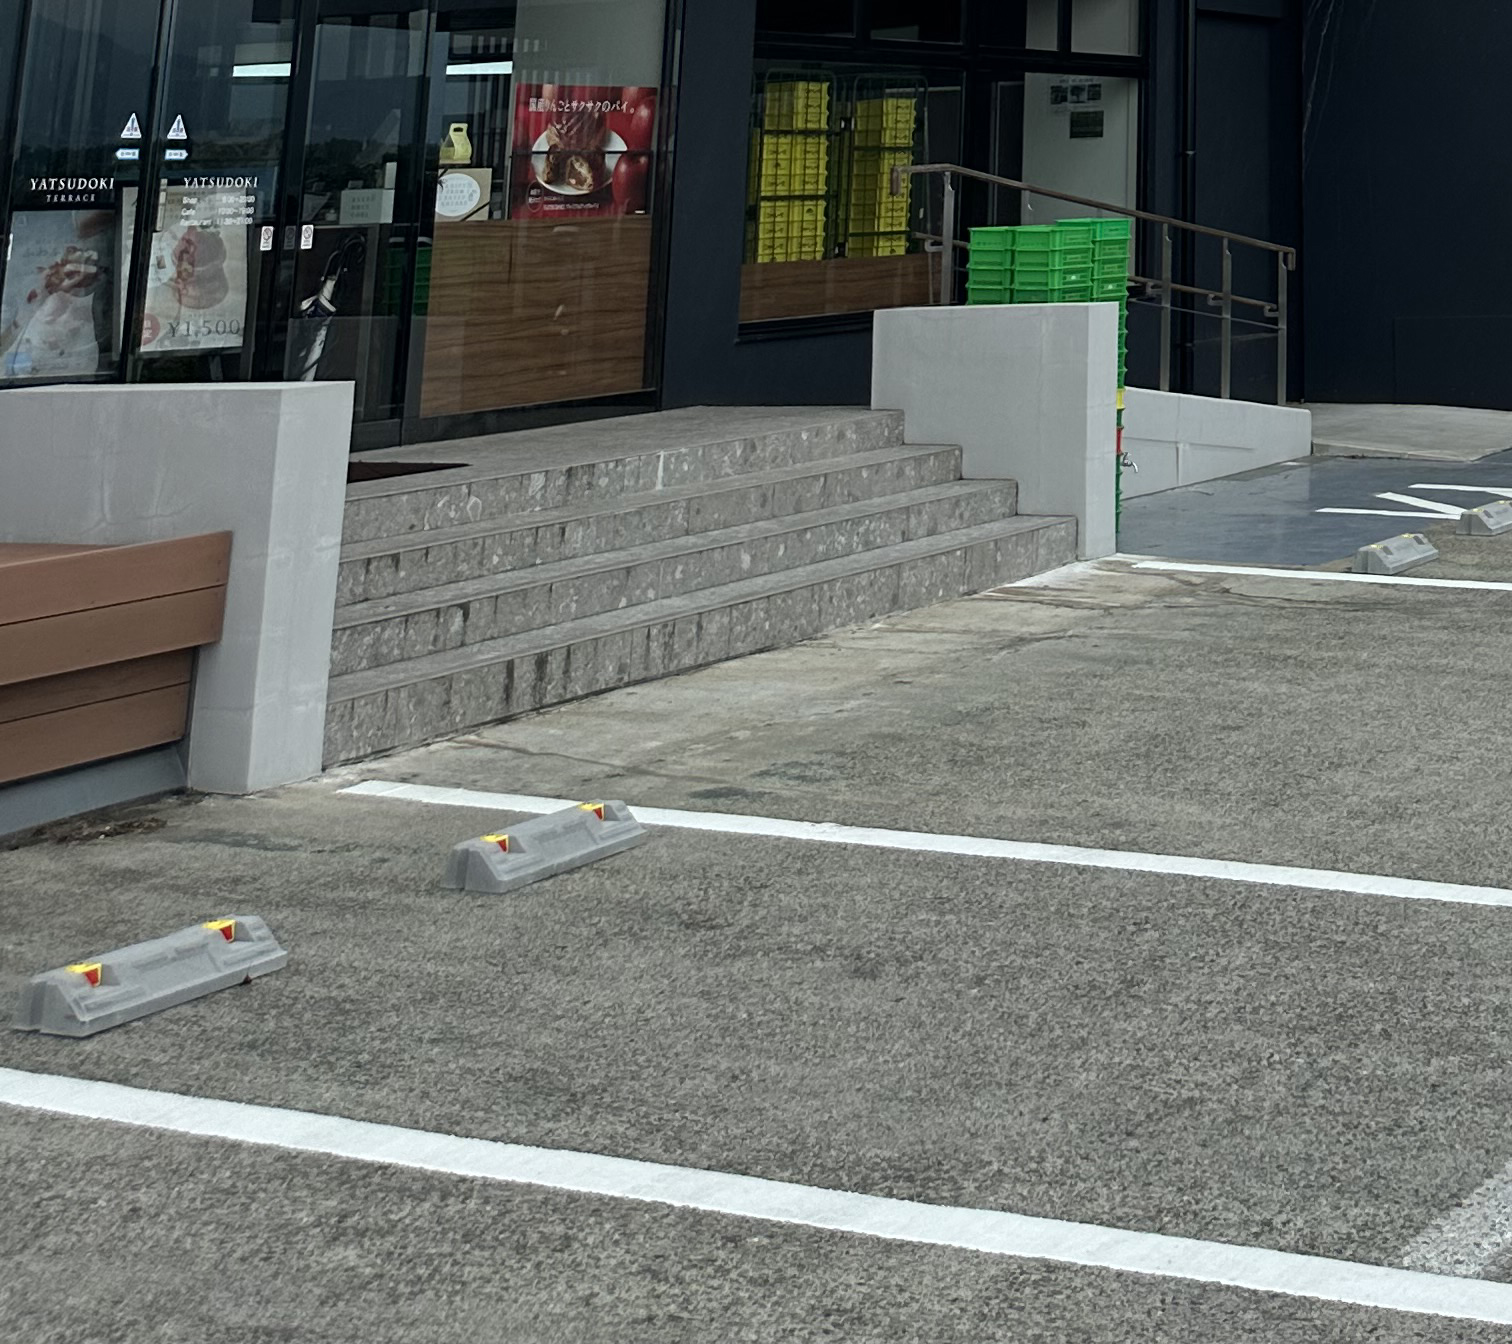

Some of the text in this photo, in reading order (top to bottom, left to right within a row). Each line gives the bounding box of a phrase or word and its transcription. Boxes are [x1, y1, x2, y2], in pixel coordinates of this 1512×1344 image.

[30, 177, 115, 191] YATSUDOKI
[183, 176, 258, 189] YATSUDOKI
[46, 193, 95, 203] TERRACE
